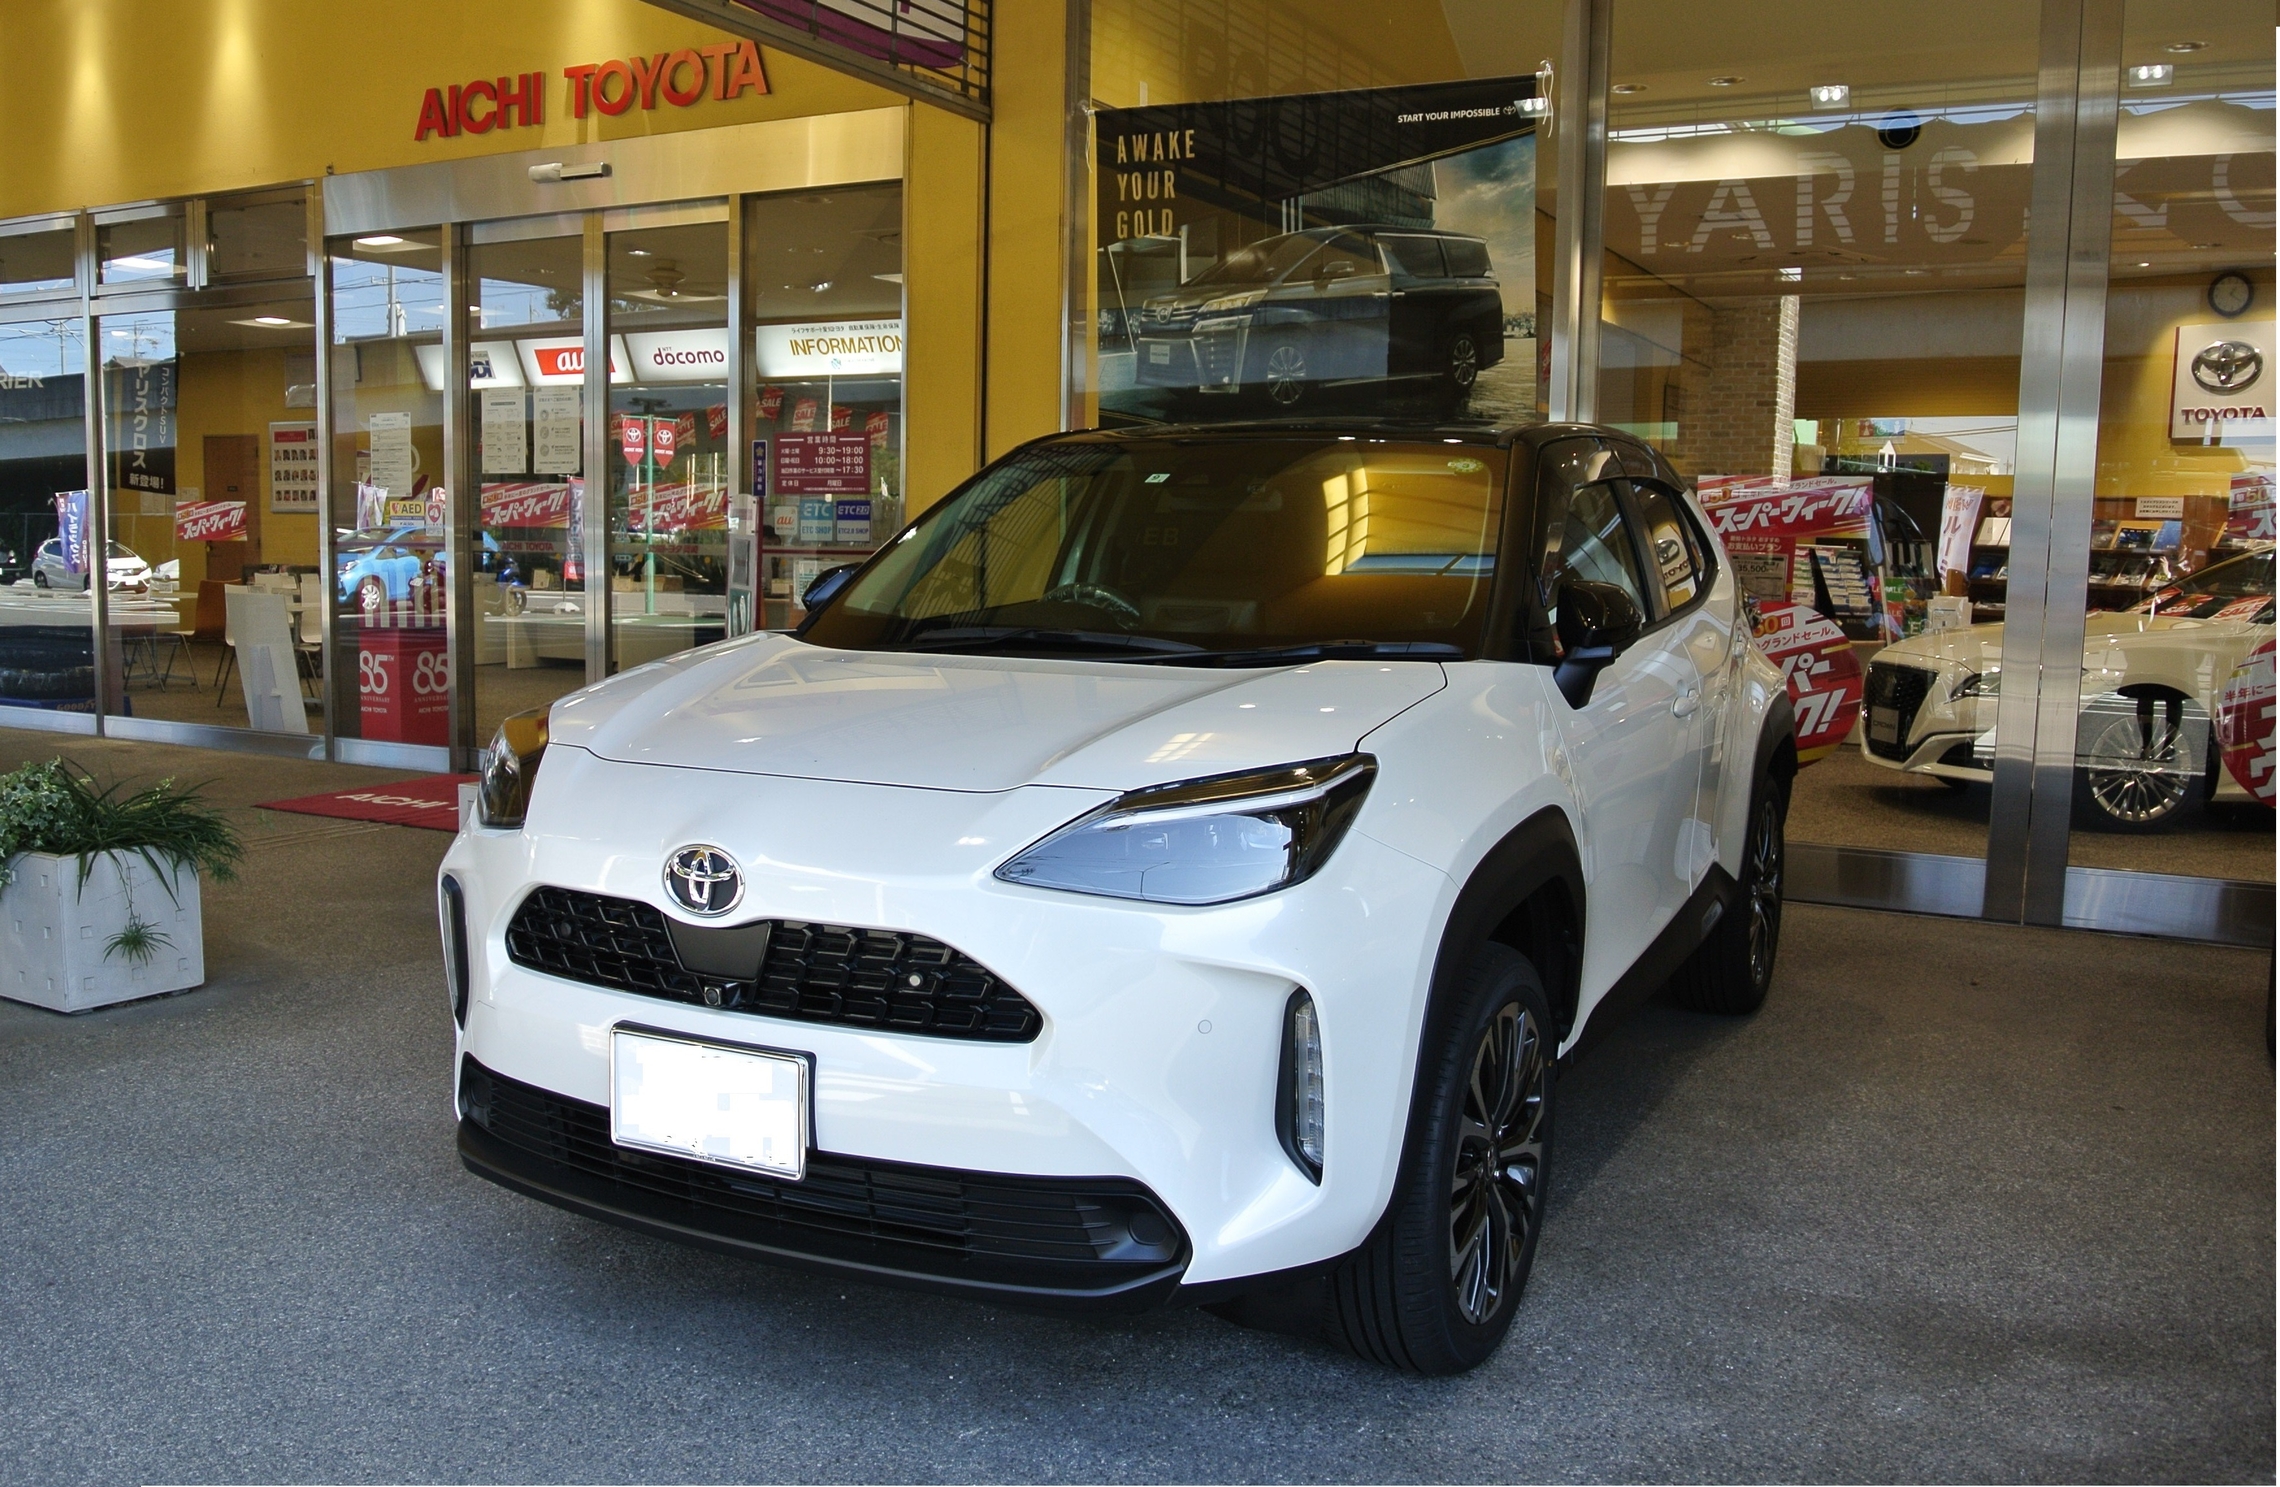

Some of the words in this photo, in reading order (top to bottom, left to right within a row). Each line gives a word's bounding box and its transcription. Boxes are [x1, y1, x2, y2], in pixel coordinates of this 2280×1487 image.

[415, 71, 544, 142] AICHI
[563, 39, 771, 119] TOYOTA
[1397, 113, 1423, 124] START
[1425, 111, 1449, 121] YOUR
[1450, 107, 1501, 119] IMPOSSIBLE
[1117, 129, 1196, 164] AWAKE
[1116, 170, 1176, 201] YOUR
[1624, 146, 1980, 255] YARIS
[653, 348, 725, 366] docomo
[761, 397, 782, 407] SALE
[709, 408, 727, 428] SALE
[2181, 406, 2267, 426] TOYOTA
[807, 435, 837, 444] 営業時間
[401, 503, 422, 515] AED
[803, 503, 832, 517] ETC
[838, 505, 856, 515] ETC
[1714, 485, 1869, 535] スーパーウィーク!
[776, 515, 794, 525] au
[802, 526, 814, 534] ETC
[815, 526, 832, 534] SHOP
[525, 541, 554, 551] TOYOTA
